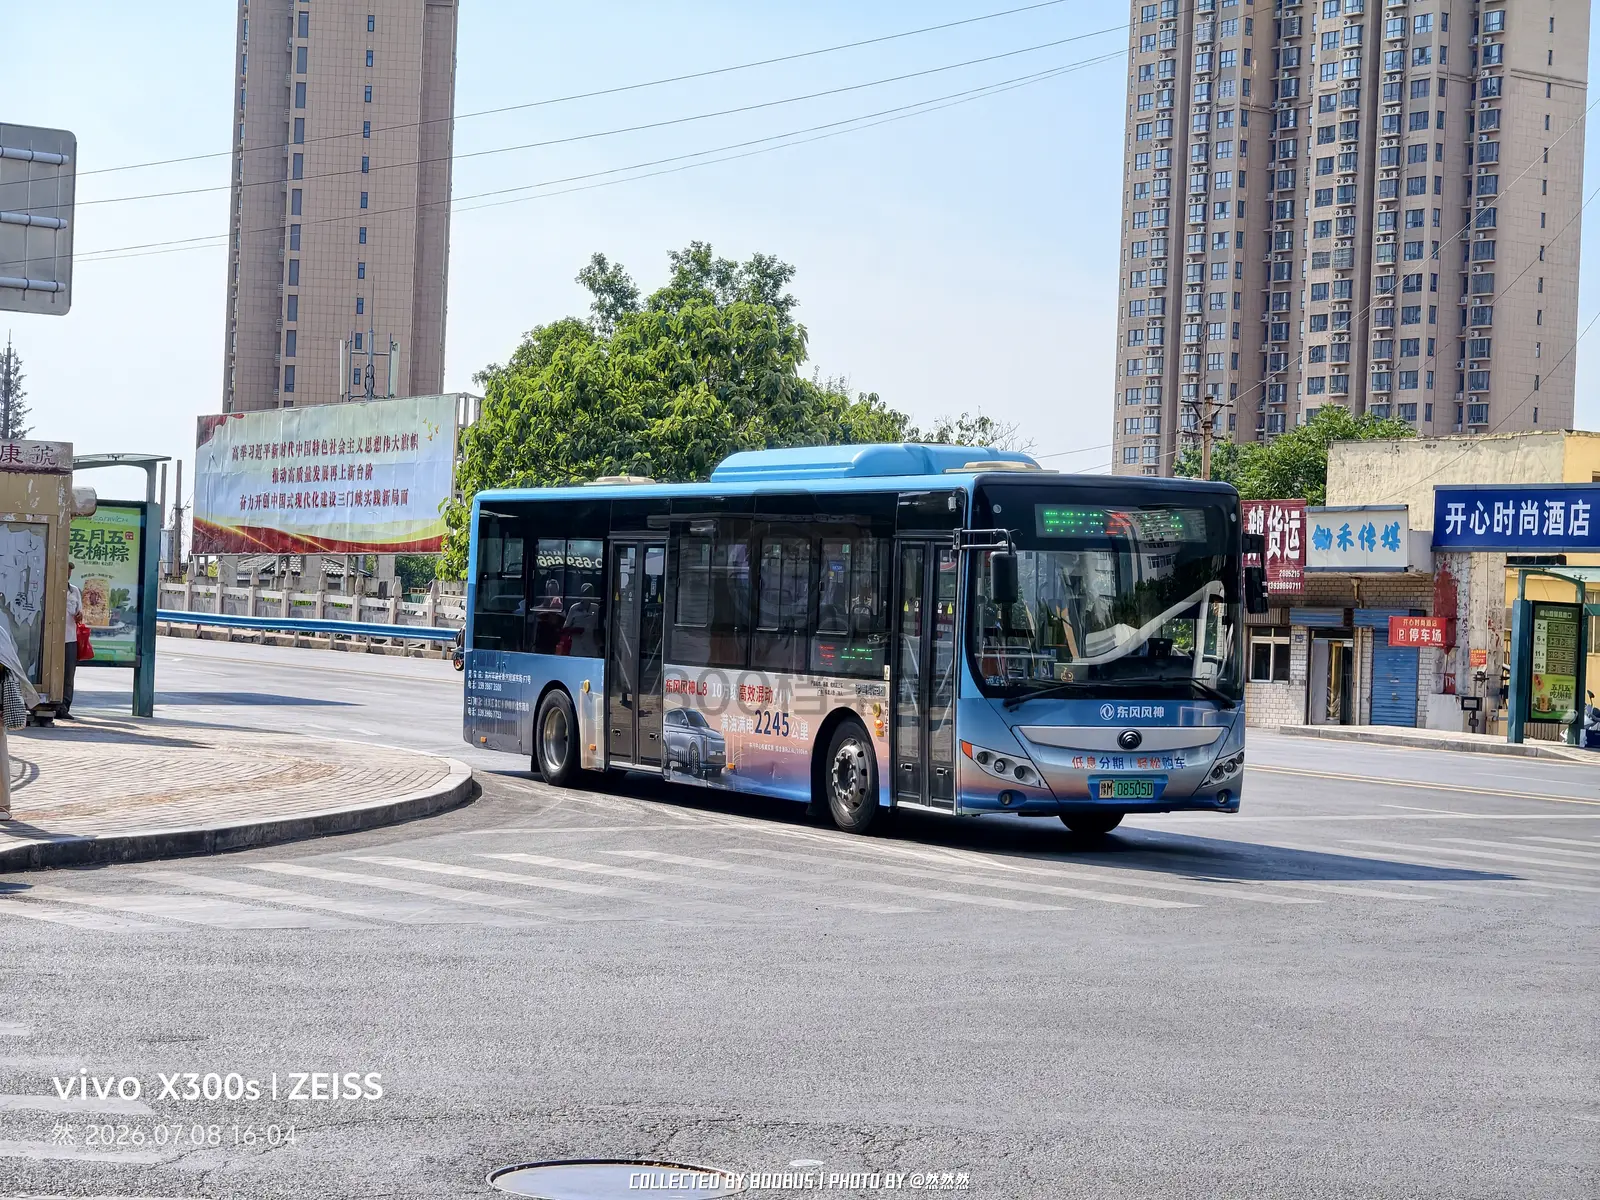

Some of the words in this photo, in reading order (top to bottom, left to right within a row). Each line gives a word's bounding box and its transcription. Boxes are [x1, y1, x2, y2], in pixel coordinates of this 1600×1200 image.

[231, 433, 419, 462] 高举习近平新时代中国特色社会主义思想伟大旗帜
[271, 463, 374, 484] 推动高质量发展再上新台阶
[239, 488, 409, 511] 奋力开创中国式现代化建设三门峡实践新局面
[1445, 499, 1591, 537] 开心时尚酒店
[69, 528, 126, 545] 五月五
[1402, 618, 1438, 627] 开心时尚酒店
[1409, 628, 1442, 642] 停车场
[1117, 706, 1165, 718] 东风风神
[1072, 755, 1124, 770] 低息分期
[1136, 755, 1186, 770] 轻松购车
